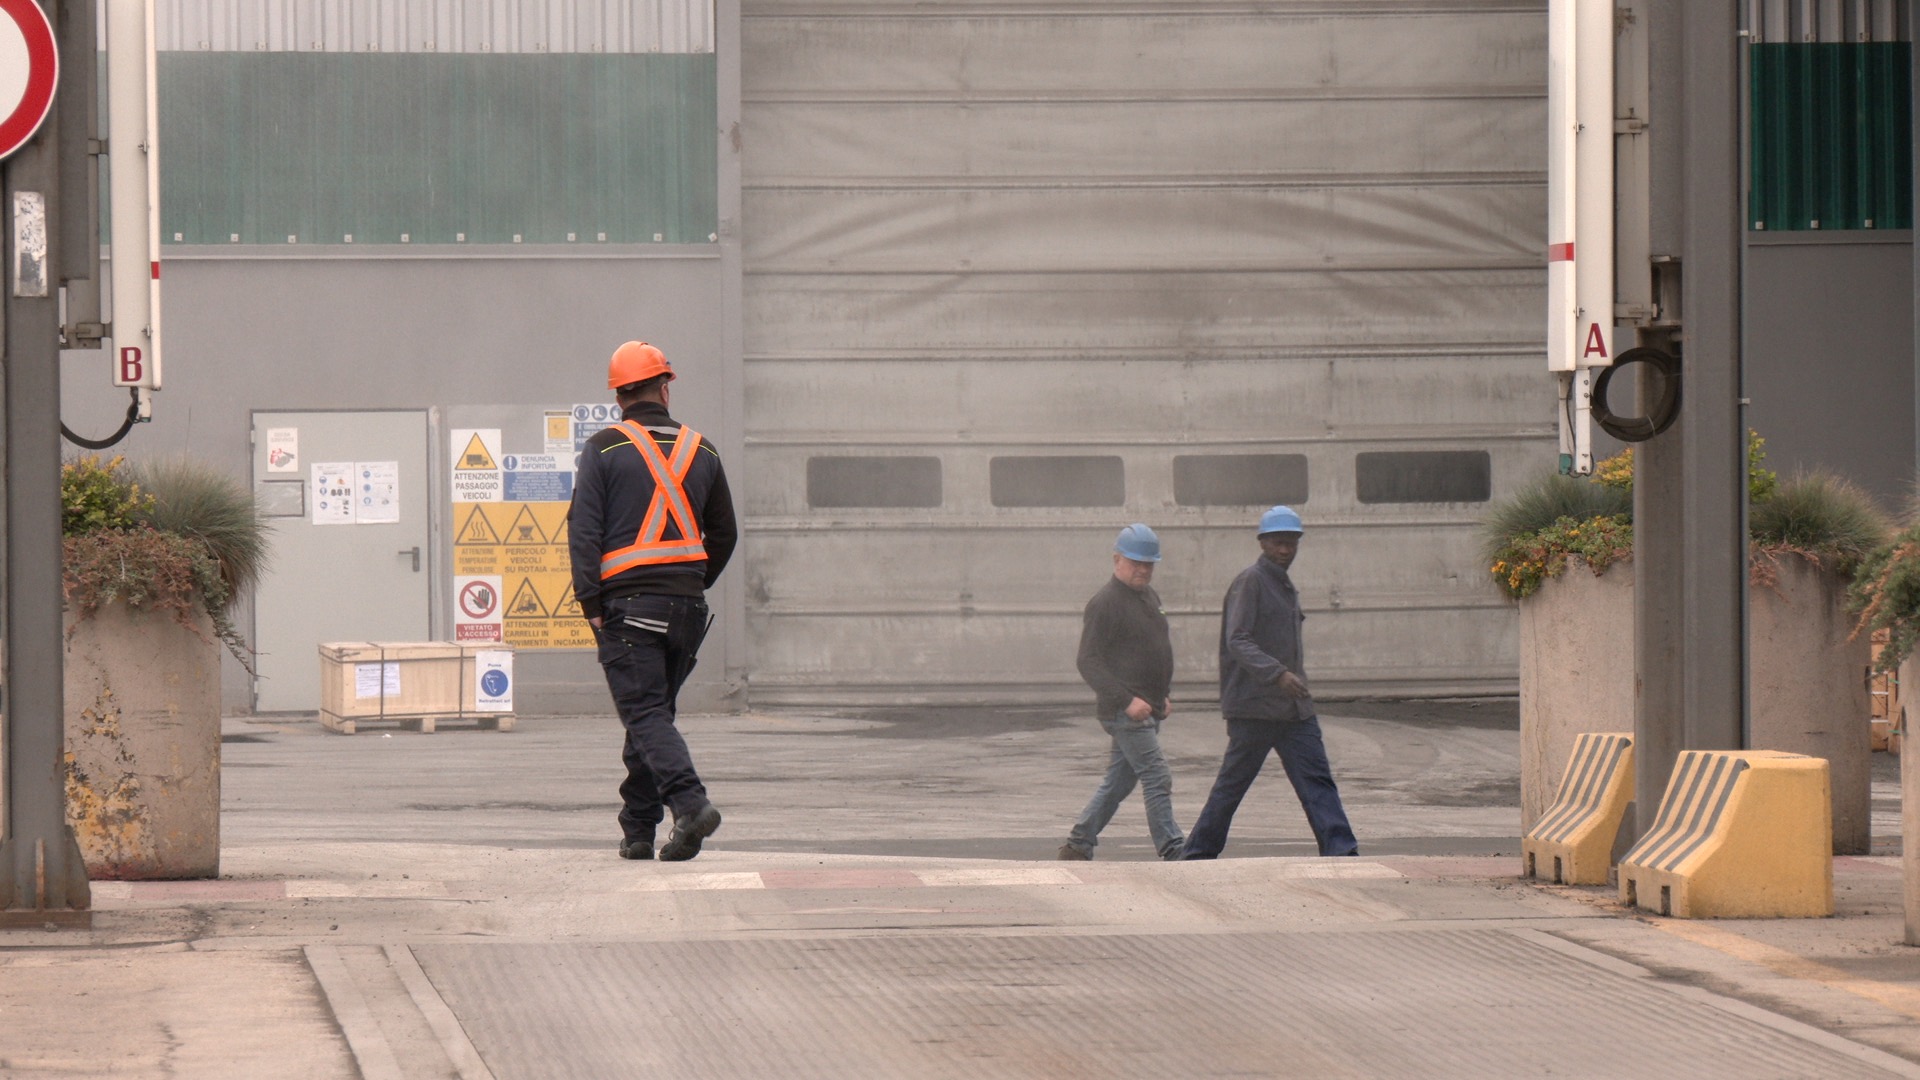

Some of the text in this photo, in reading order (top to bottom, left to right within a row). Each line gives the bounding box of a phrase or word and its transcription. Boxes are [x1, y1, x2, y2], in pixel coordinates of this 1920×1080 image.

[1584, 323, 1608, 358] A
[120, 346, 143, 382] B
[521, 455, 556, 463] DENUNCIA
[521, 462, 557, 470] INFORTUNI
[454, 472, 499, 480] ATTENZIONE
[455, 482, 498, 490] PASSAGGIO
[462, 491, 492, 500] VEICOLI
[505, 547, 547, 555] PERICOLO
[510, 556, 542, 564] VEICOLI
[504, 565, 547, 573] SU ROTAIA
[553, 620, 590, 628] PERICOL
[570, 629, 580, 637] DI
[553, 638, 597, 646] INCIAMPO
